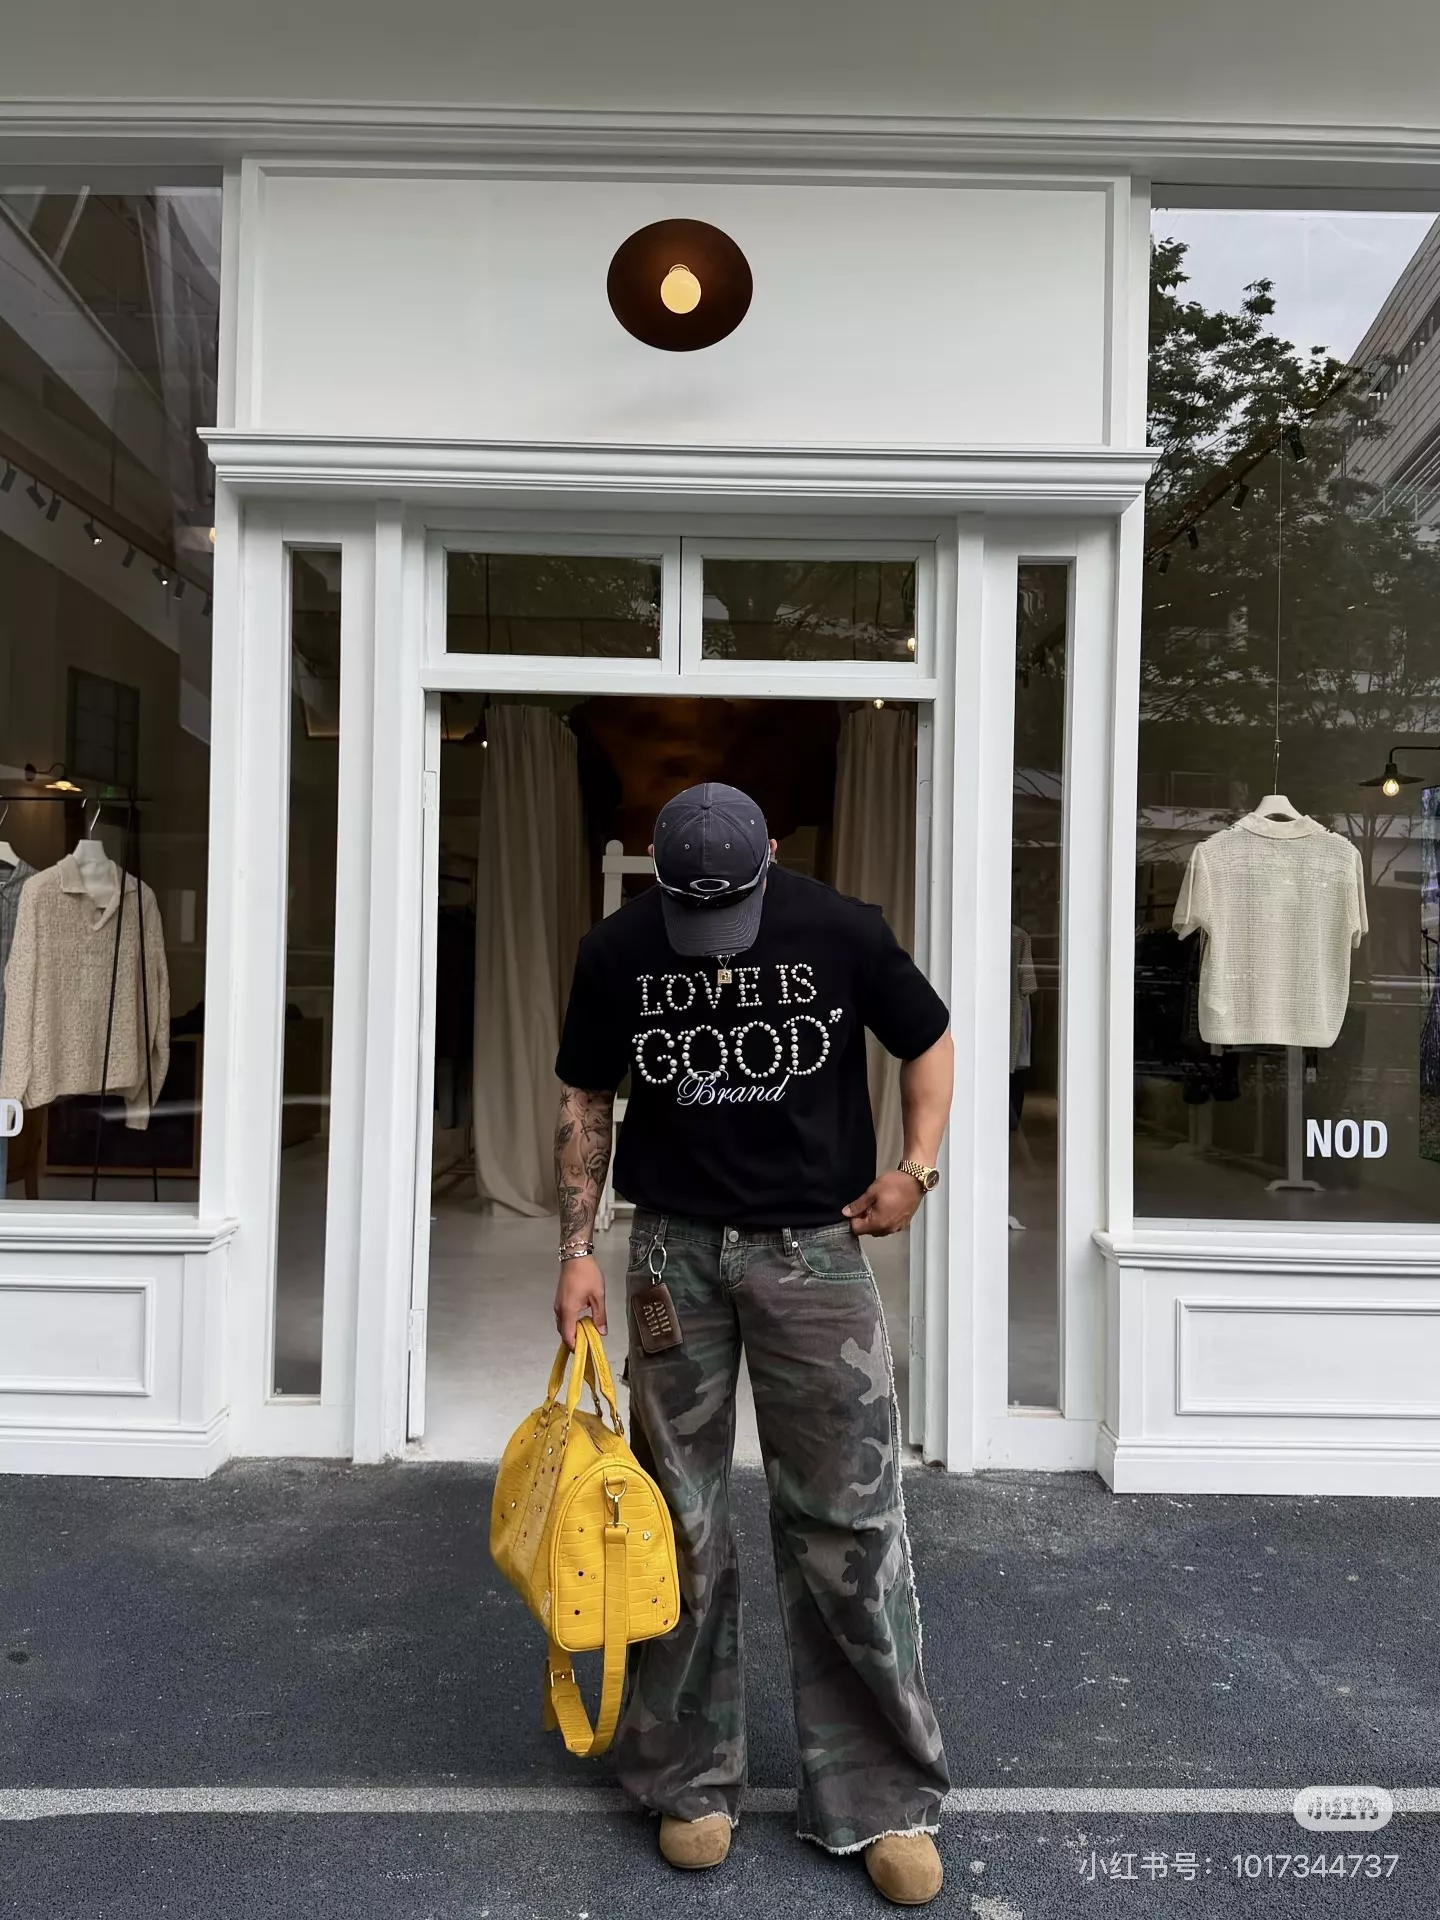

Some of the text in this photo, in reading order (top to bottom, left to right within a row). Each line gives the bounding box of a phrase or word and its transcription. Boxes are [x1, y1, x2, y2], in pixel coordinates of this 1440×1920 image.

[637, 963, 818, 1016] LOVE IS
[676, 1070, 790, 1106] Brand
[1306, 1119, 1388, 1159] NOD
